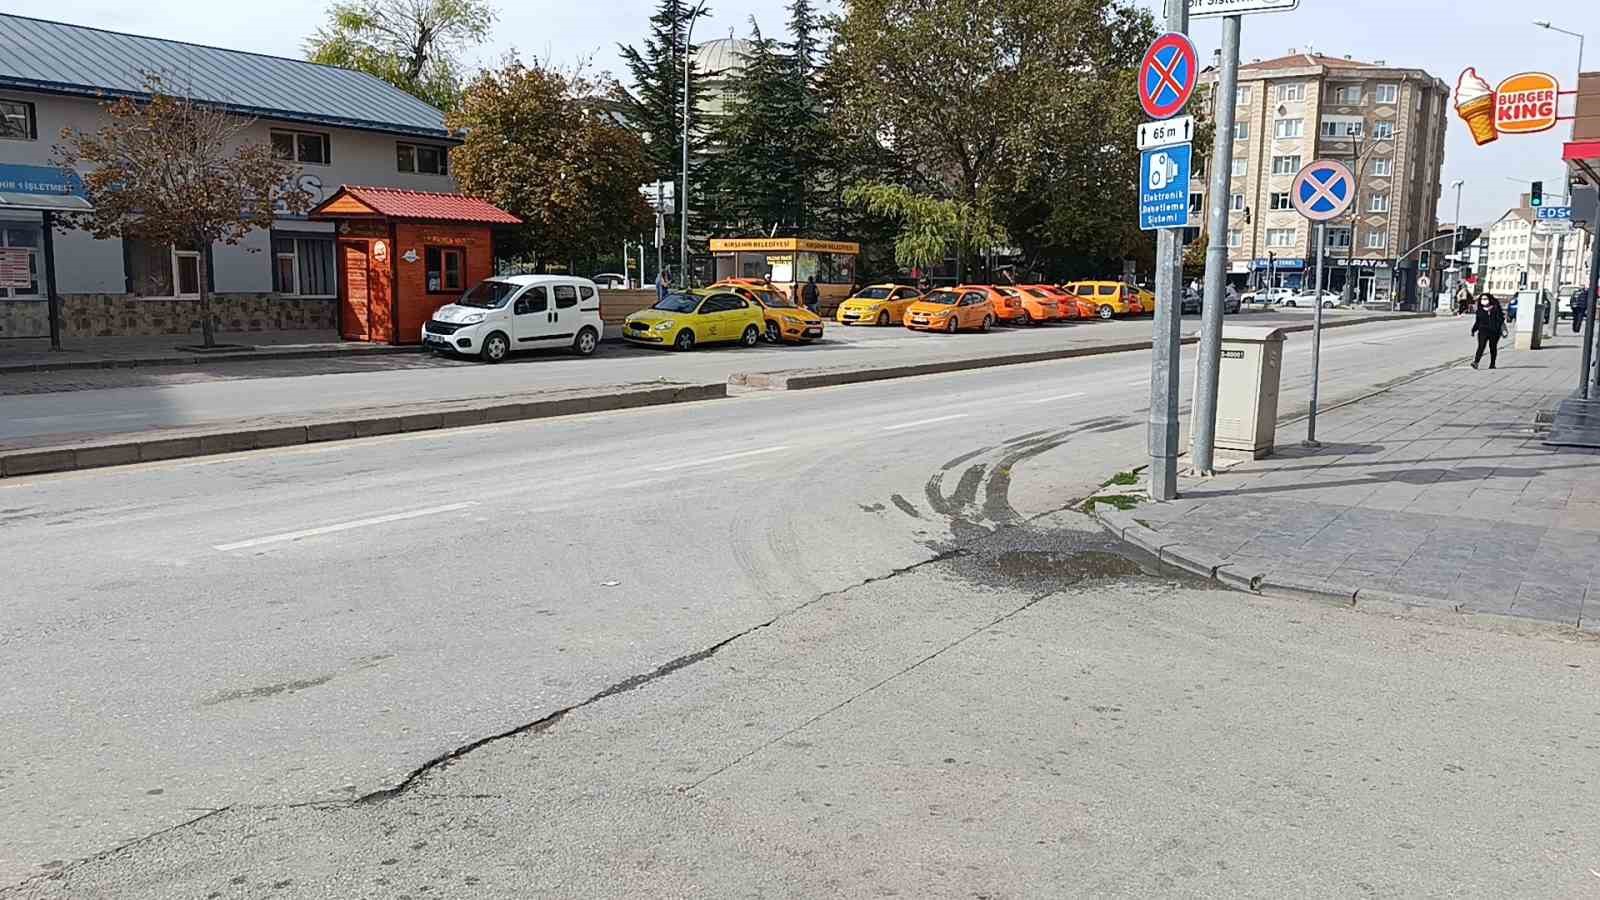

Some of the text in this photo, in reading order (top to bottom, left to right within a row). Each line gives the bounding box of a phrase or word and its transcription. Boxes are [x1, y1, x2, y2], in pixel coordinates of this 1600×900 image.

[1499, 91, 1553, 105] BURGER
[1498, 102, 1553, 120] KING
[1153, 127, 1176, 139] 65 m
[1143, 191, 1184, 202] Elektronik
[1538, 208, 1566, 218] EDS
